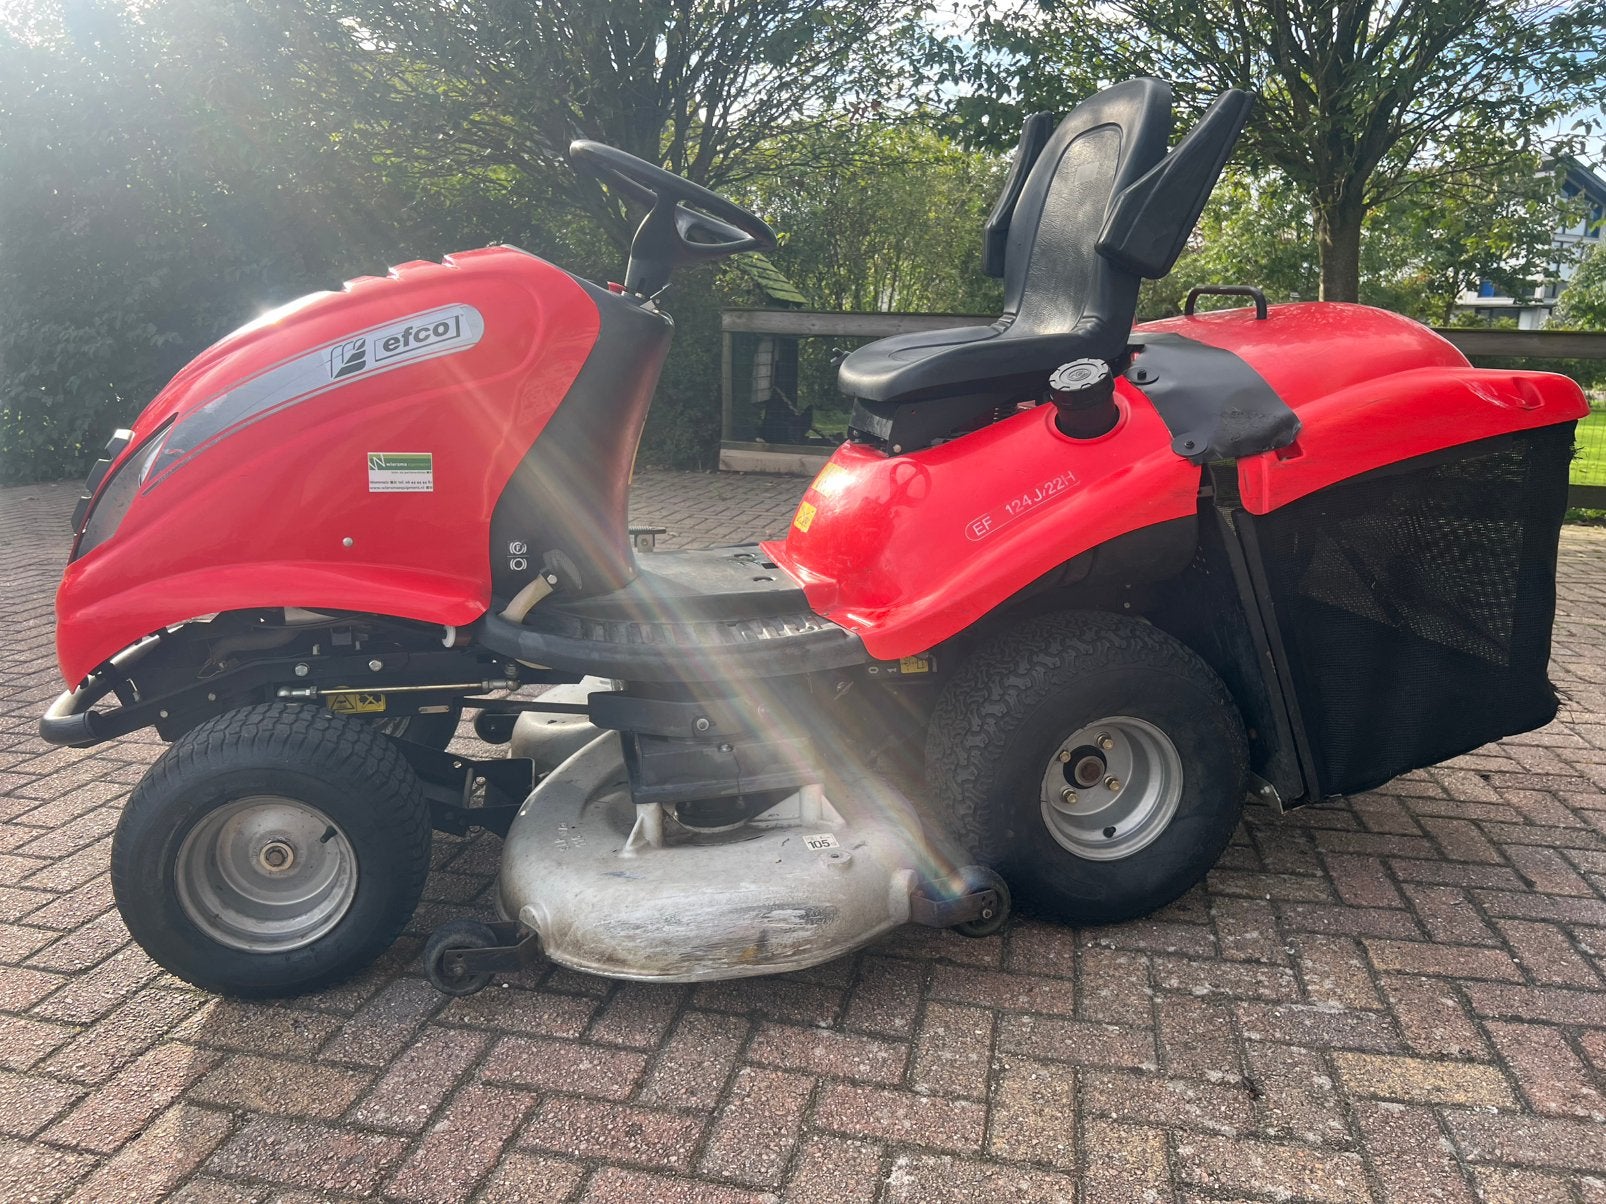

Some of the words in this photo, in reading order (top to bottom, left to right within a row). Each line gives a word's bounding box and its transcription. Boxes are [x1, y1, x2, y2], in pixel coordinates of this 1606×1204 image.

[382, 321, 450, 353] efco
[972, 515, 993, 537] EF
[1005, 493, 1033, 515] 124
[808, 839, 831, 849] 105
